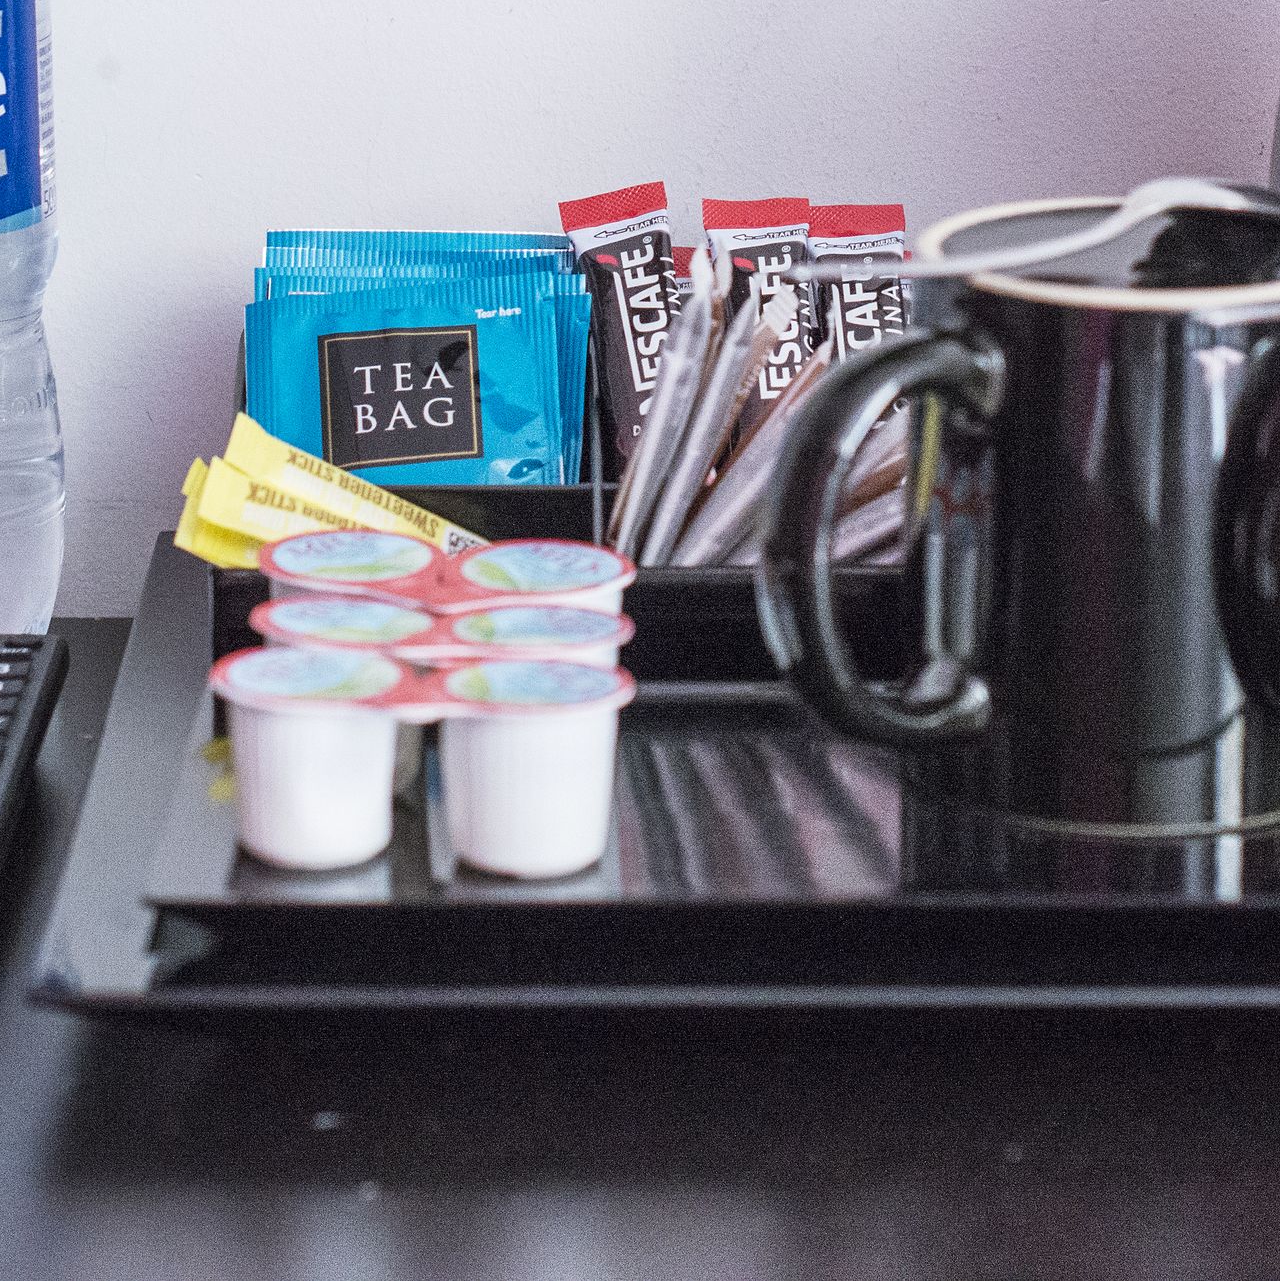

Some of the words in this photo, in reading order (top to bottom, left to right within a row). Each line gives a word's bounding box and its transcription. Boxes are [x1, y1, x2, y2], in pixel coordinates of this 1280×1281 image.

[627, 220, 650, 232] TEAR
[767, 230, 791, 240] TEAR
[848, 242, 873, 251] TEAR
[474, 308, 497, 319] Tear
[499, 306, 521, 317] here
[353, 361, 455, 395] TEA
[353, 397, 456, 435] BAG
[286, 449, 334, 484] STICK
[245, 481, 297, 514] STICK
